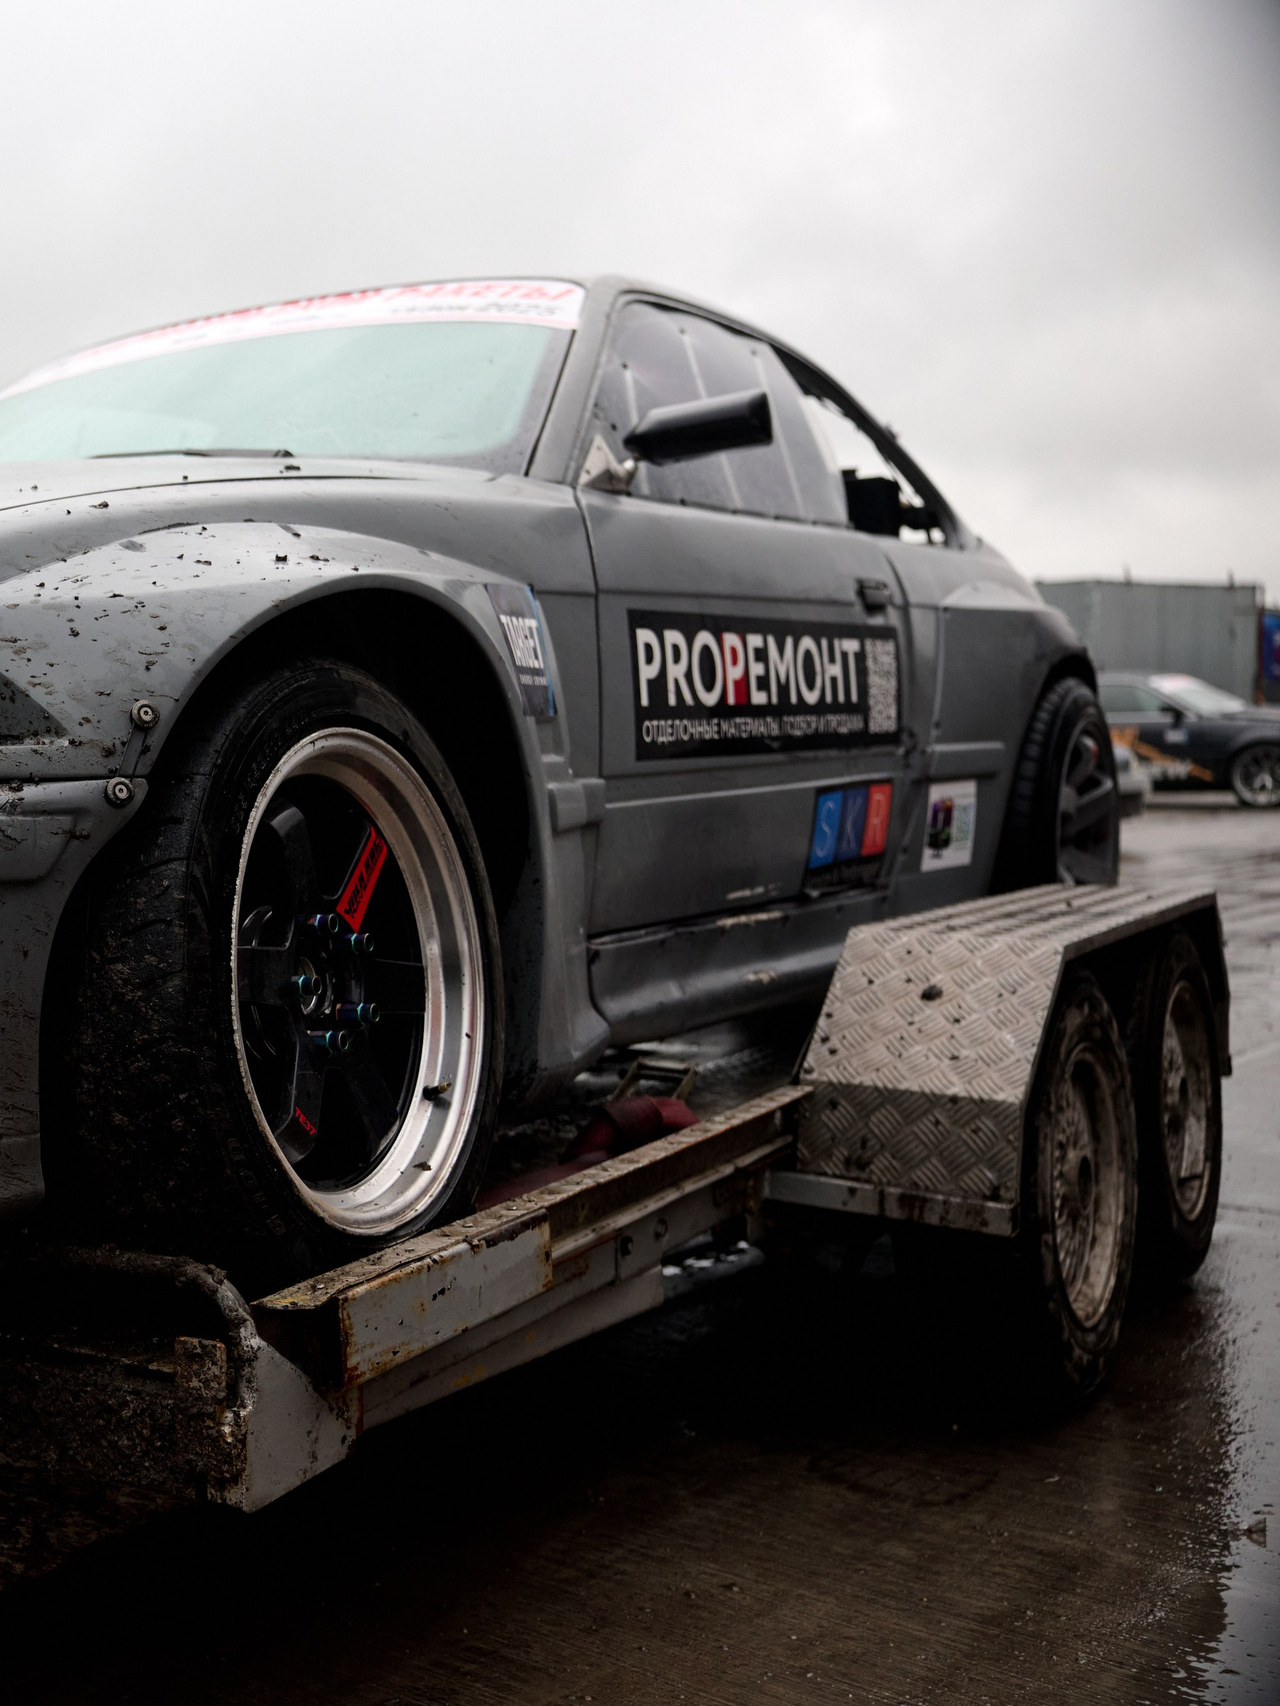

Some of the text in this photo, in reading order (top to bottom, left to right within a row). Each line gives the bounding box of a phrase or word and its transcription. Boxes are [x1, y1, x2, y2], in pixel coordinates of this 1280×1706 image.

[642, 718, 719, 744] ОТДЕЛОЧНЫЕ
[815, 792, 887, 858] SKR
[295, 1105, 317, 1136] TE37
